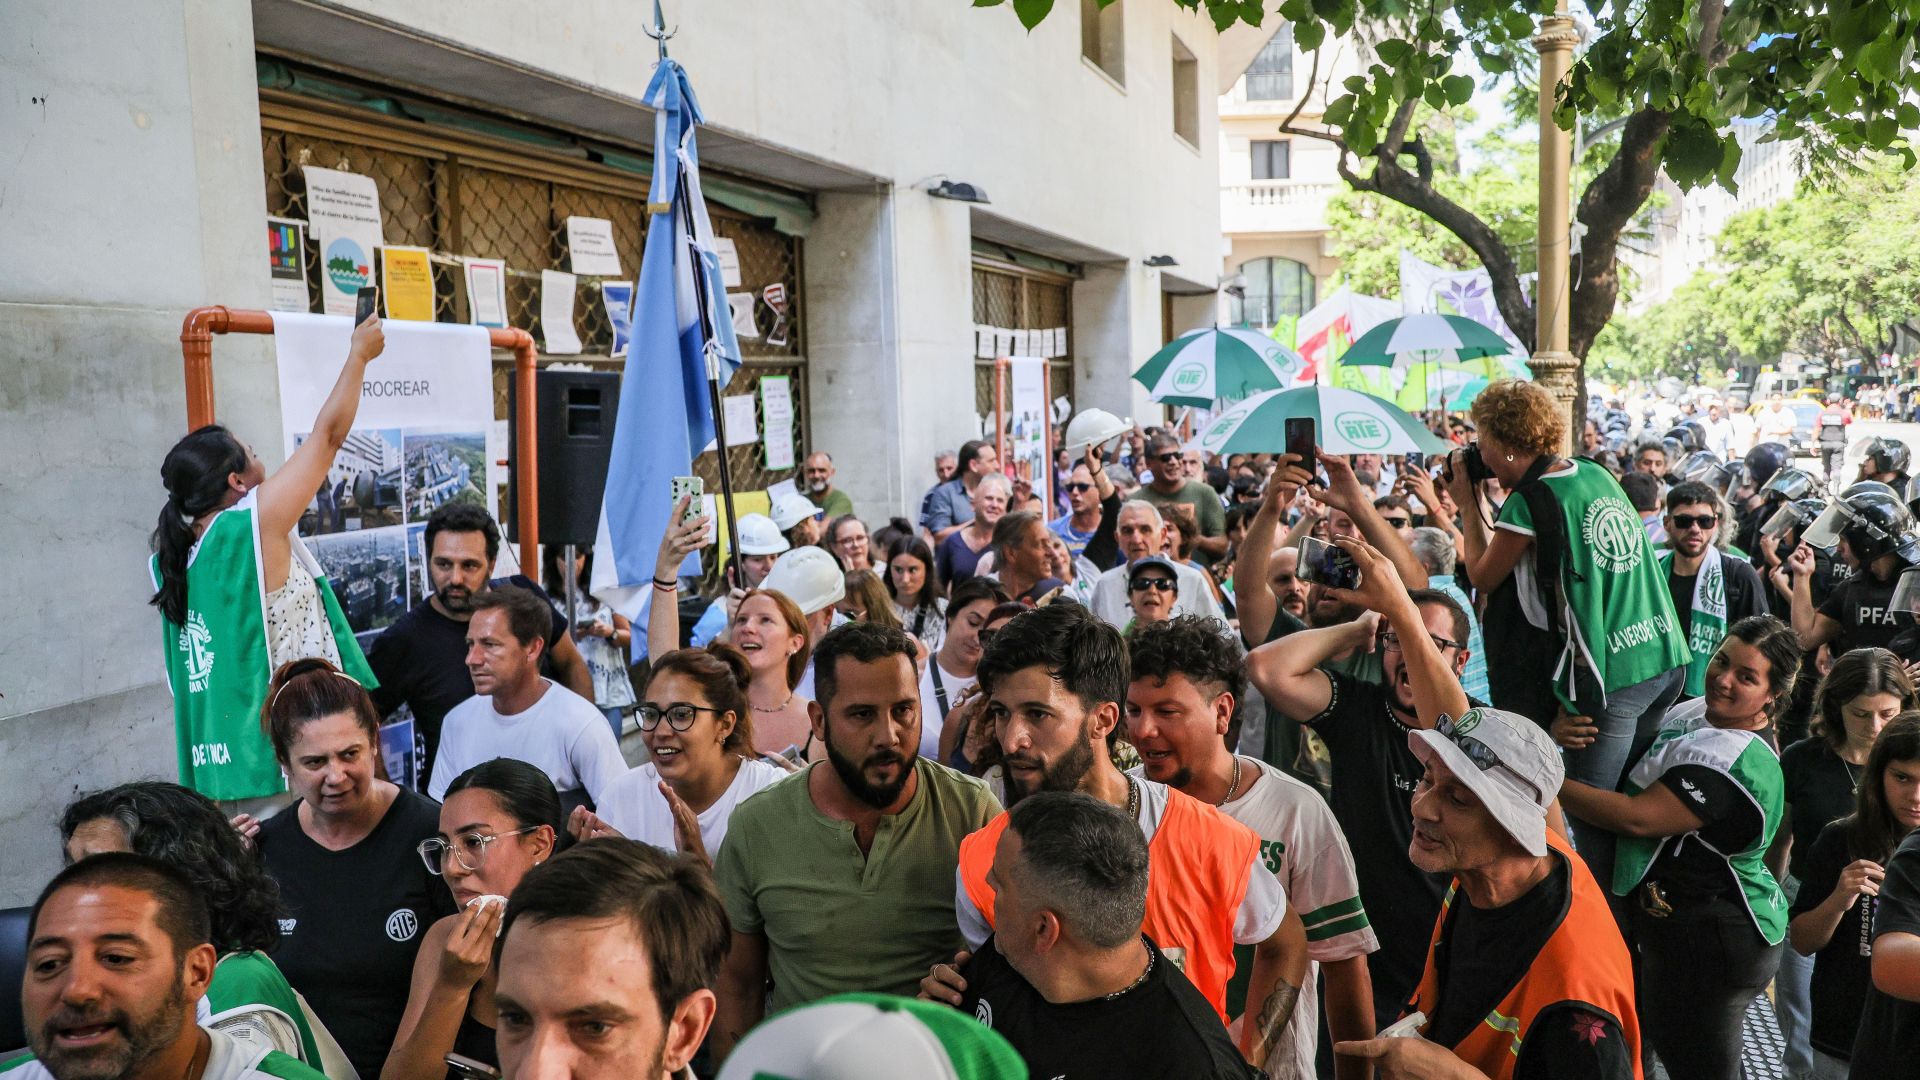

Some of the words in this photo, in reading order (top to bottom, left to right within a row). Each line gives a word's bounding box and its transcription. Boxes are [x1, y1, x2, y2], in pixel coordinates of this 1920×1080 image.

[363, 380, 430, 397] ROCREAR
[1345, 424, 1382, 439] ATE
[1597, 511, 1634, 558] ATE
[1833, 563, 1853, 579] PFA
[1859, 607, 1897, 625] PFA
[1618, 619, 1653, 648] VERDE
[388, 911, 416, 939] ATE
